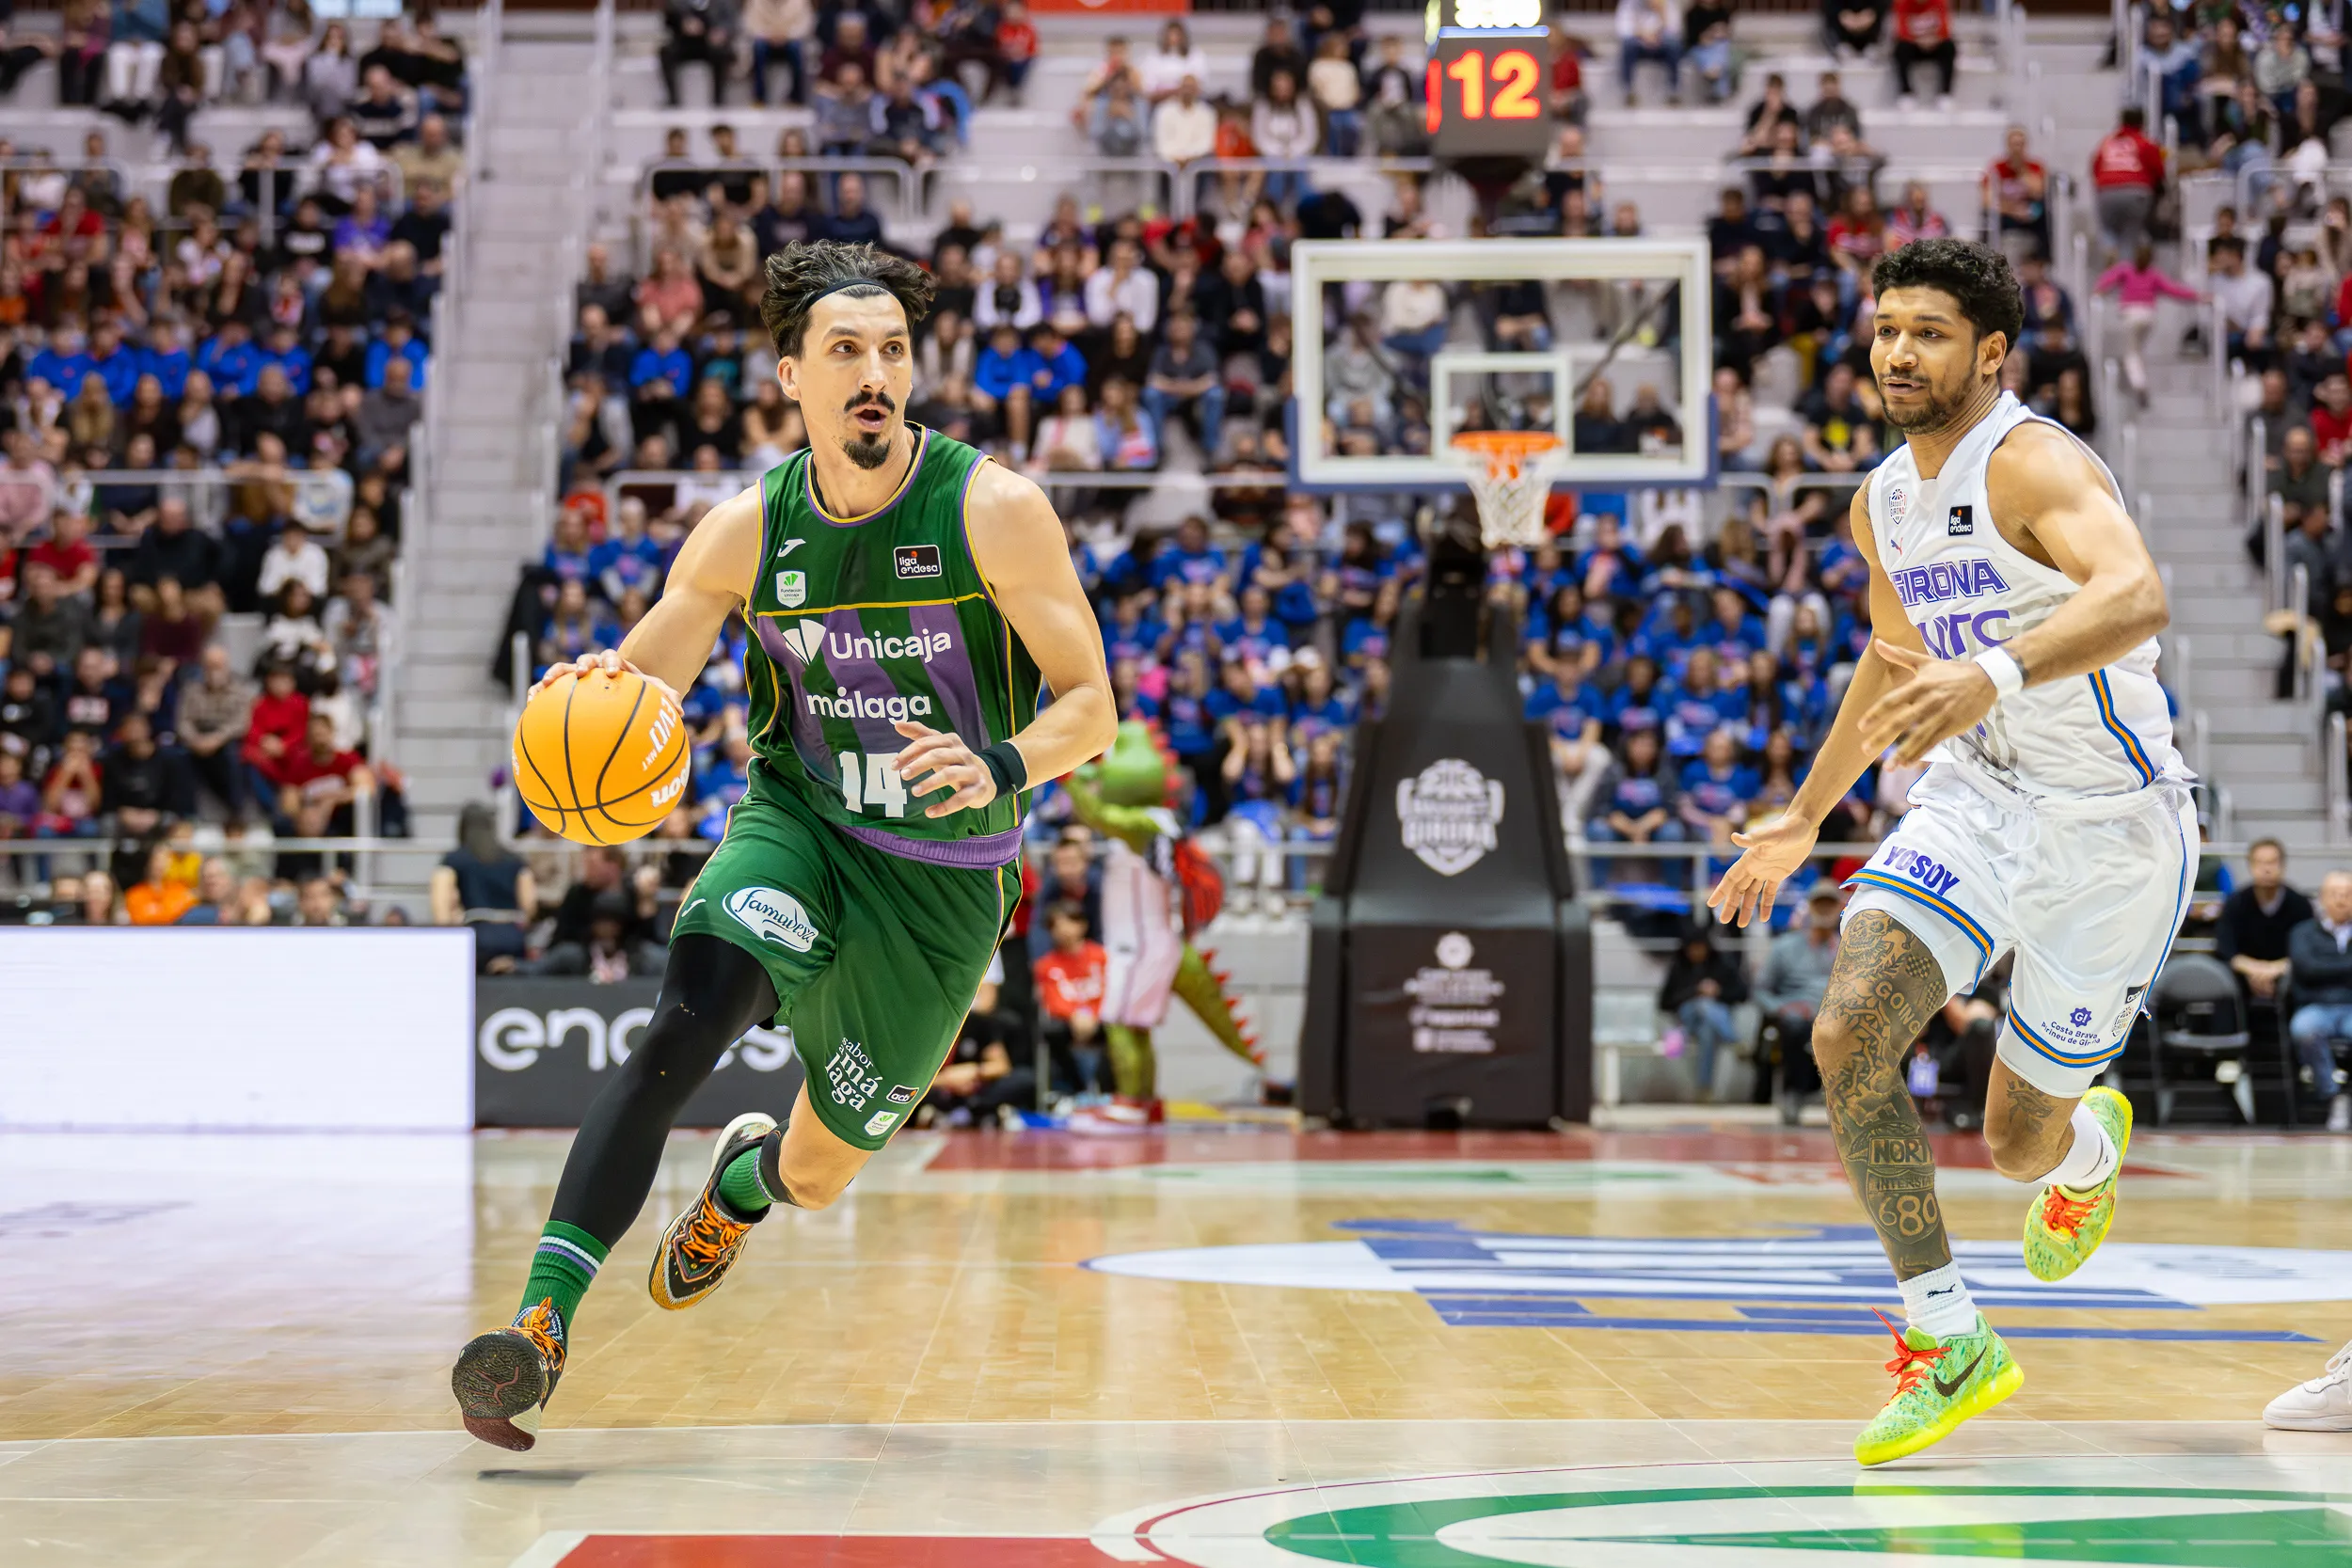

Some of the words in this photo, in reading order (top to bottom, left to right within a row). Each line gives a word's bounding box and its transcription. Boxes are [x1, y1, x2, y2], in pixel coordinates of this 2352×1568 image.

[1446, 49, 1541, 119] 12
[1950, 524, 1972, 533] endesa
[899, 557, 916, 567] liga
[900, 564, 939, 575] endesa
[829, 628, 952, 663] Unicaja
[839, 751, 907, 817] 14
[1883, 846, 1961, 896] YOSOY
[1875, 981, 1920, 1036] GOING
[2041, 1022, 2066, 1042] Pirineu
[2079, 1037, 2101, 1047] Girna
[2051, 1021, 2074, 1035] Costa
[2075, 1031, 2098, 1039] Brava
[842, 1037, 873, 1069] sabor
[891, 1093, 911, 1101] acb
[1873, 1139, 1931, 1164] NORT
[1879, 1192, 1937, 1237] 680
